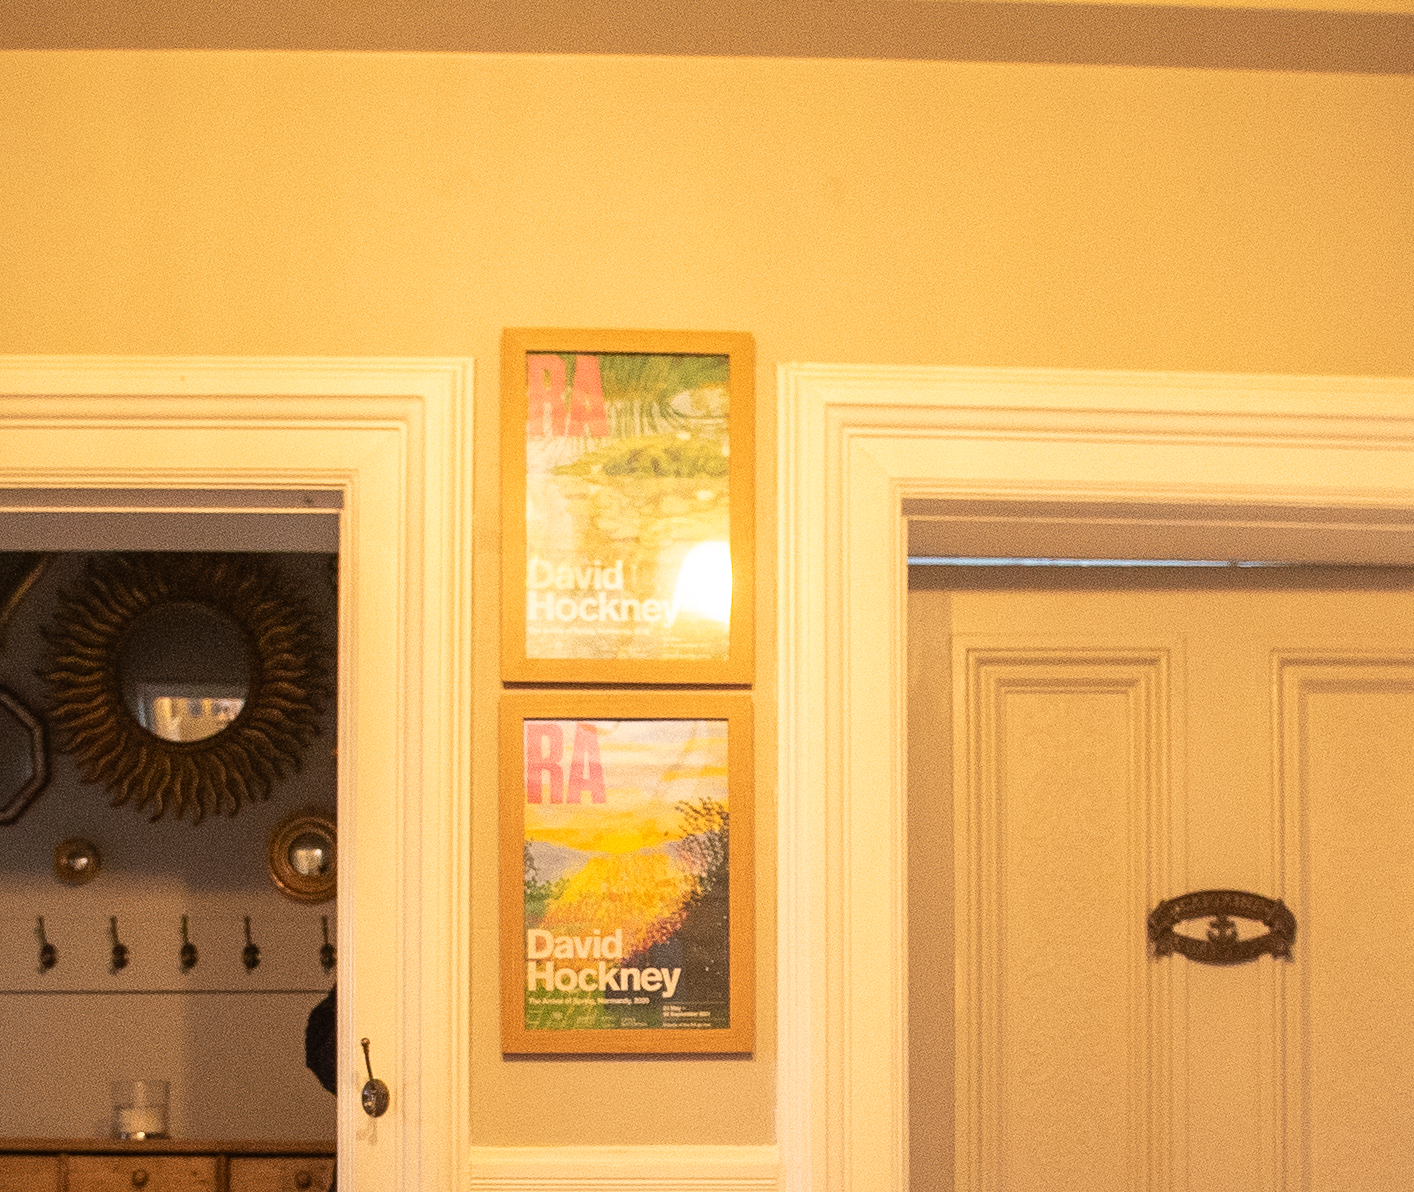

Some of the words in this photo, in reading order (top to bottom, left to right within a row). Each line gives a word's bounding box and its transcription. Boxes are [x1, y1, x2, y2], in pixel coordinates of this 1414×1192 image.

[528, 355, 609, 437] RA
[527, 560, 623, 589] David
[527, 591, 680, 628] Hockney
[527, 723, 606, 804] RA
[527, 929, 623, 958] David
[527, 961, 682, 998] Hockney
